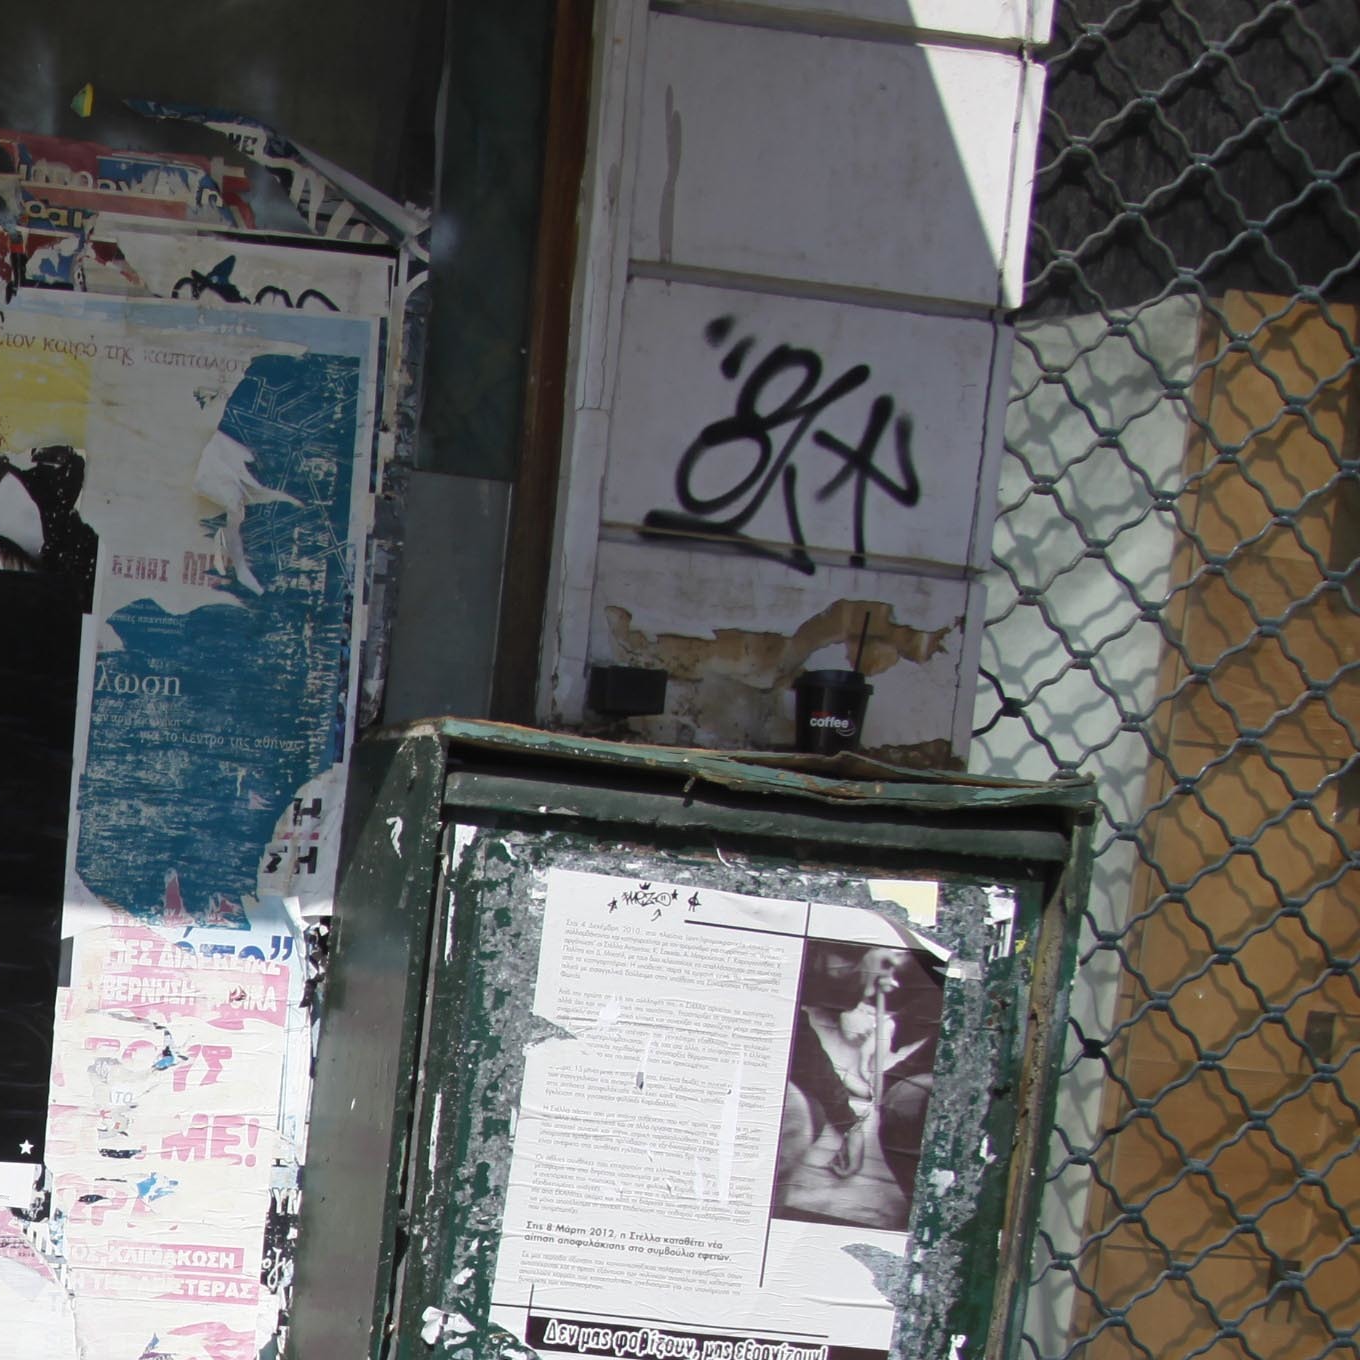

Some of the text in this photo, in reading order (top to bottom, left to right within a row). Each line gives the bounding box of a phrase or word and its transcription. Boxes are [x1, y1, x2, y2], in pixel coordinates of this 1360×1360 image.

[42, 335, 99, 359] καιρό
[103, 344, 136, 366] της
[809, 716, 849, 729] coffee
[524, 1233, 732, 1263] αίτηση αποφυλάκισης στο συμβούλιο εφετών.
[555, 1224, 724, 1250] Μάρτη 2012, Στέλλα καταθέτει νέα
[544, 1319, 578, 1347] Δεν
[580, 1329, 611, 1351] μας
[614, 1331, 700, 1360] φοβίζουν,
